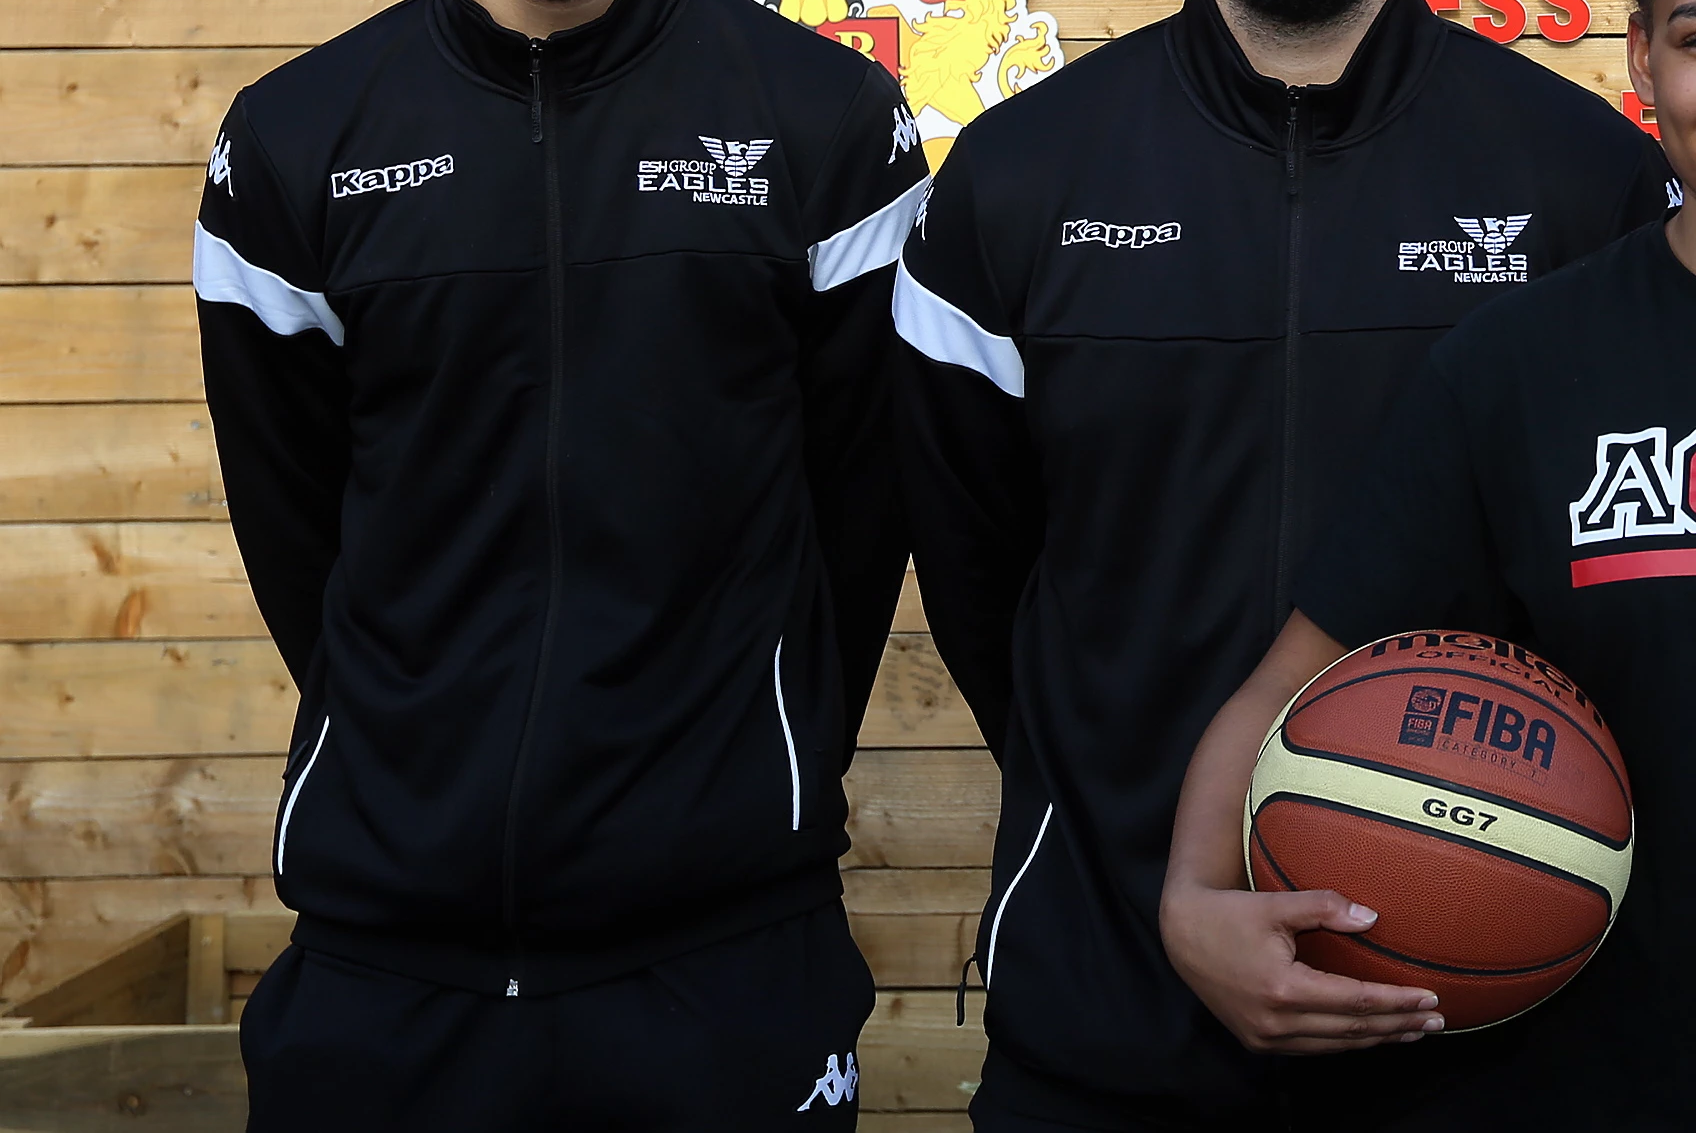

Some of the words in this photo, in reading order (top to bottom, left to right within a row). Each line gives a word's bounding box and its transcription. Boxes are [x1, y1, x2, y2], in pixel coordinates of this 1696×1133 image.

[330, 153, 455, 199] Kappa
[638, 160, 668, 174] ESH
[669, 161, 717, 175] GROUP
[636, 173, 770, 194] EAGLES
[692, 191, 769, 206] NEWCASTLE
[1061, 218, 1182, 249] Kappa
[1398, 242, 1427, 255] ESH
[1428, 240, 1476, 255] GROUP
[1397, 253, 1528, 272] EAGLES
[1453, 271, 1528, 284] NEWCASTLE
[1370, 633, 1603, 730] molten
[1416, 650, 1568, 706] OFFICIAL
[1407, 717, 1433, 732] FIBA
[1441, 690, 1557, 771] FIBA
[1442, 739, 1517, 769] CATEGORY
[1421, 797, 1499, 832] GG7
